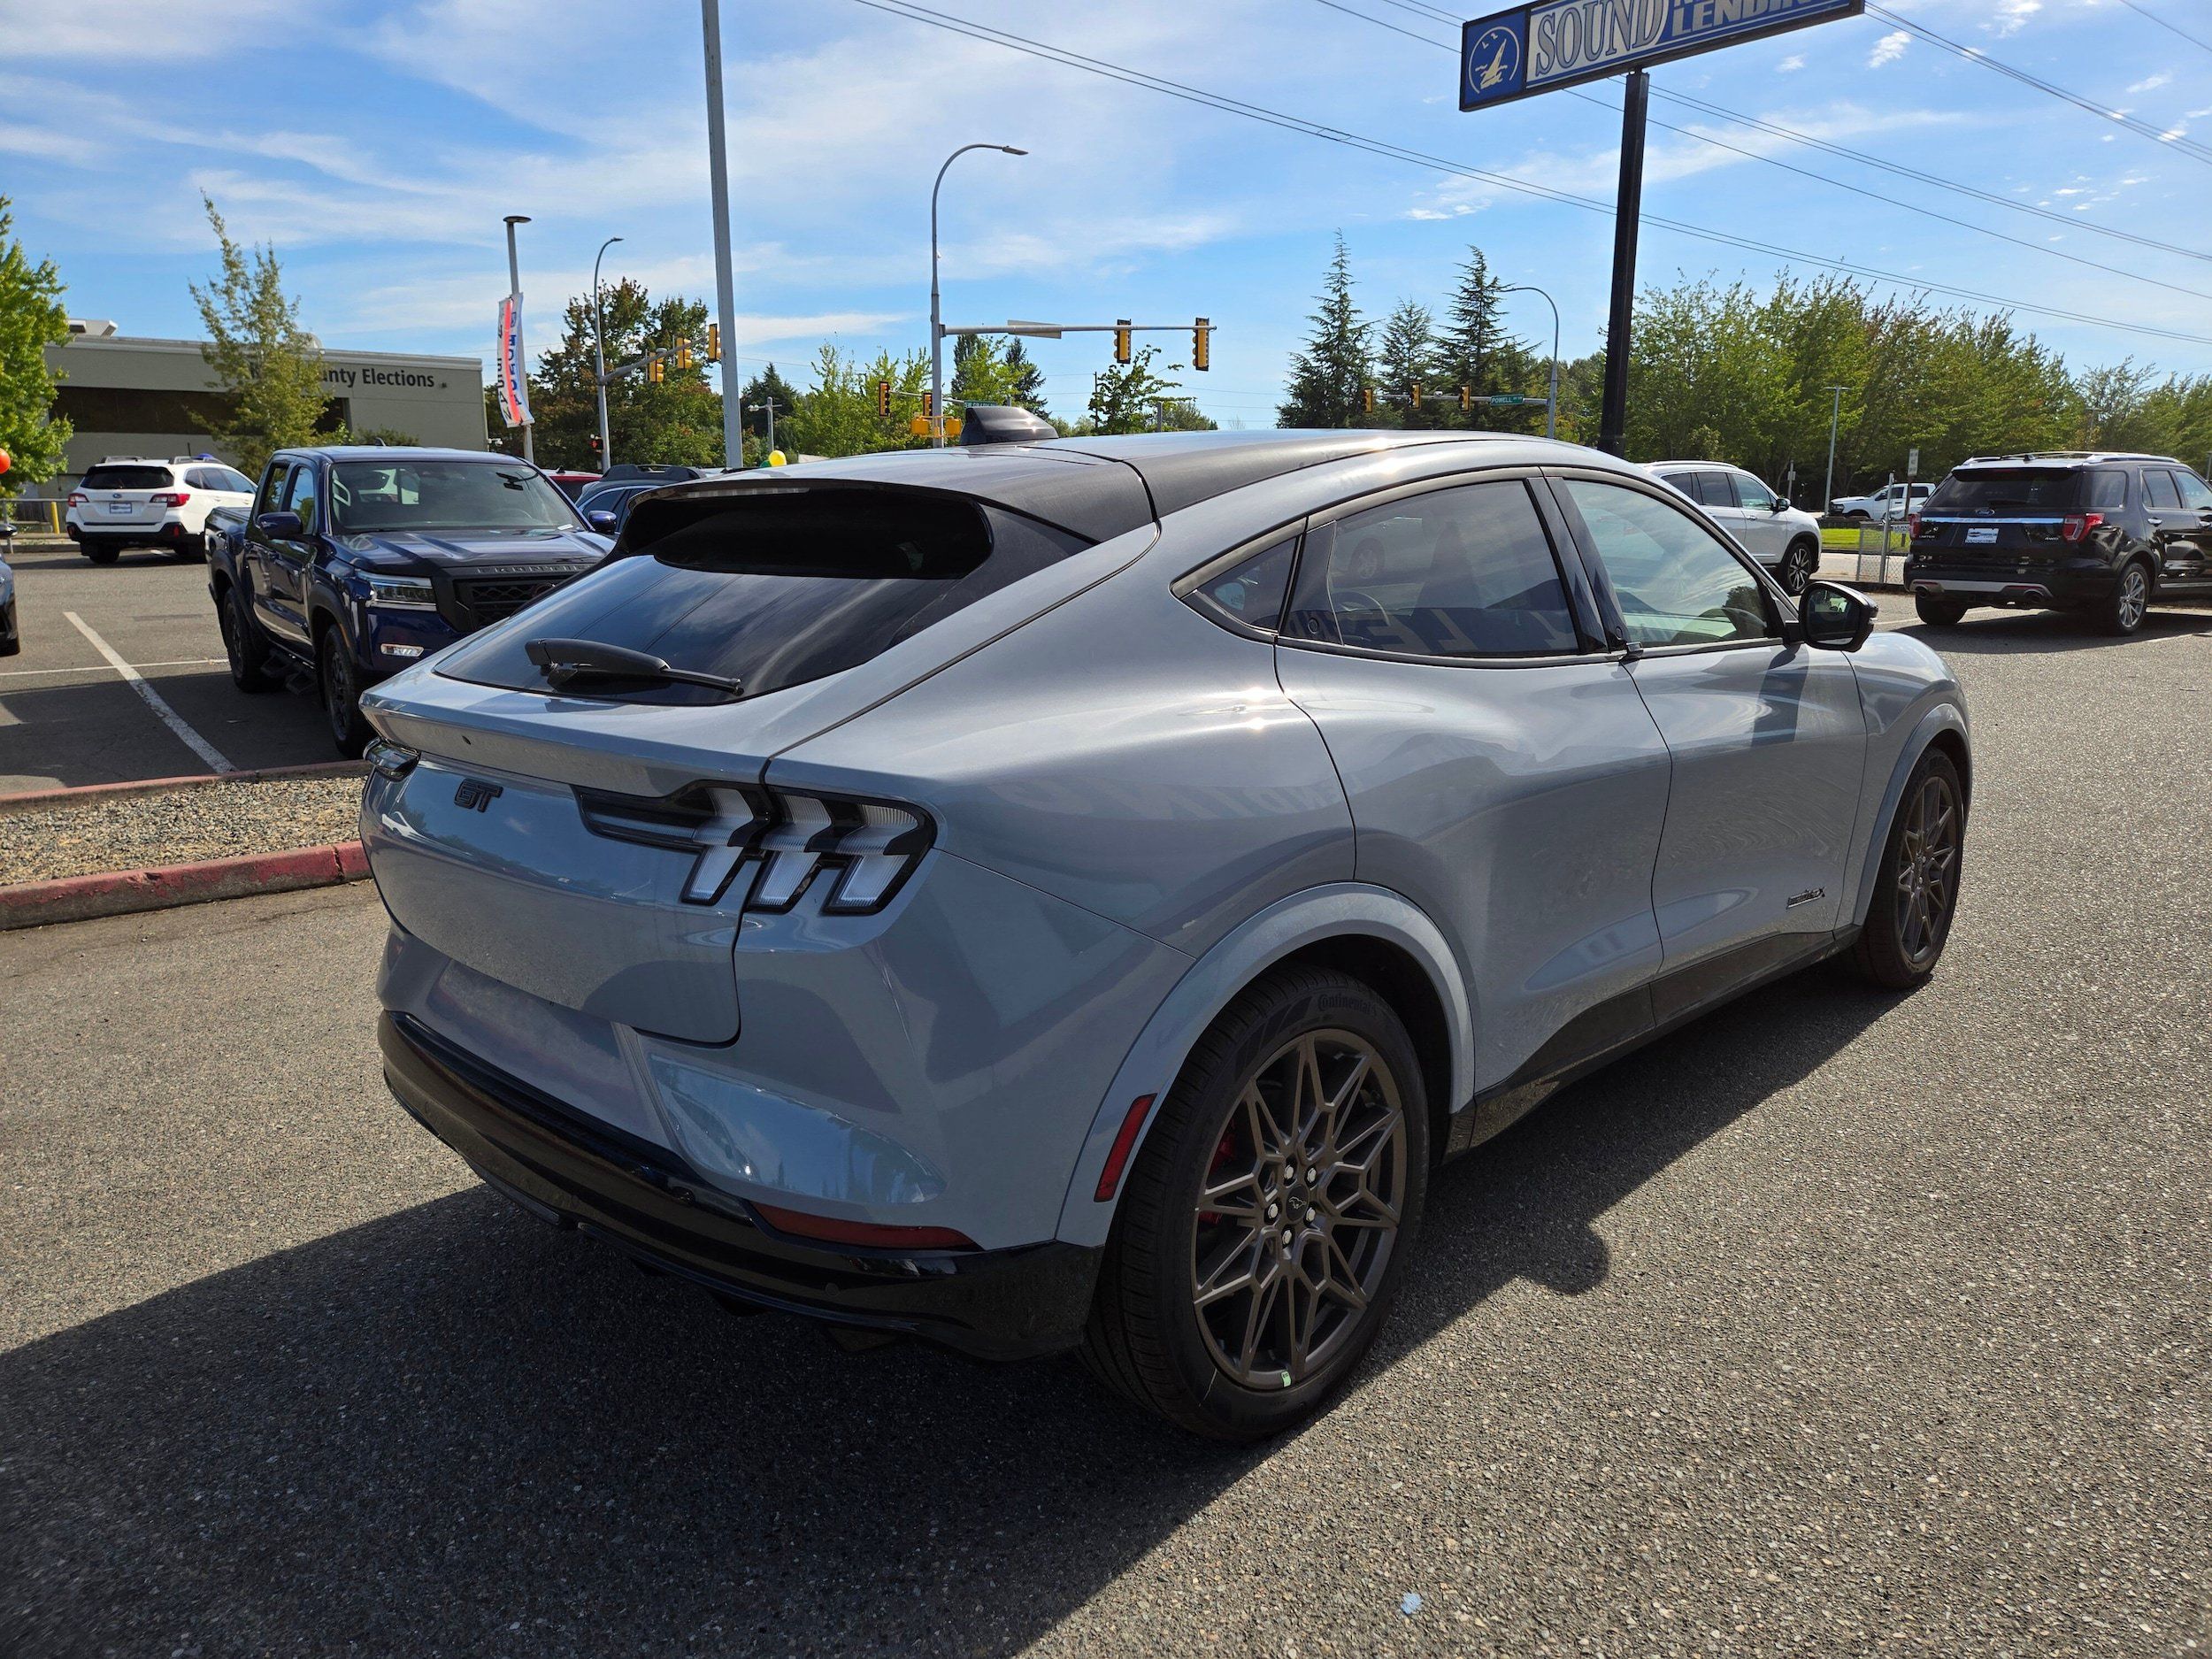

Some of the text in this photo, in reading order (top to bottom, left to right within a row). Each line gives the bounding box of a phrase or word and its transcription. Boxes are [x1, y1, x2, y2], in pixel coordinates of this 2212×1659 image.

[1535, 0, 1664, 76] SOUND
[363, 368, 434, 388] Elections
[454, 779, 503, 813] GT
[1317, 992, 1374, 1015] Continental
